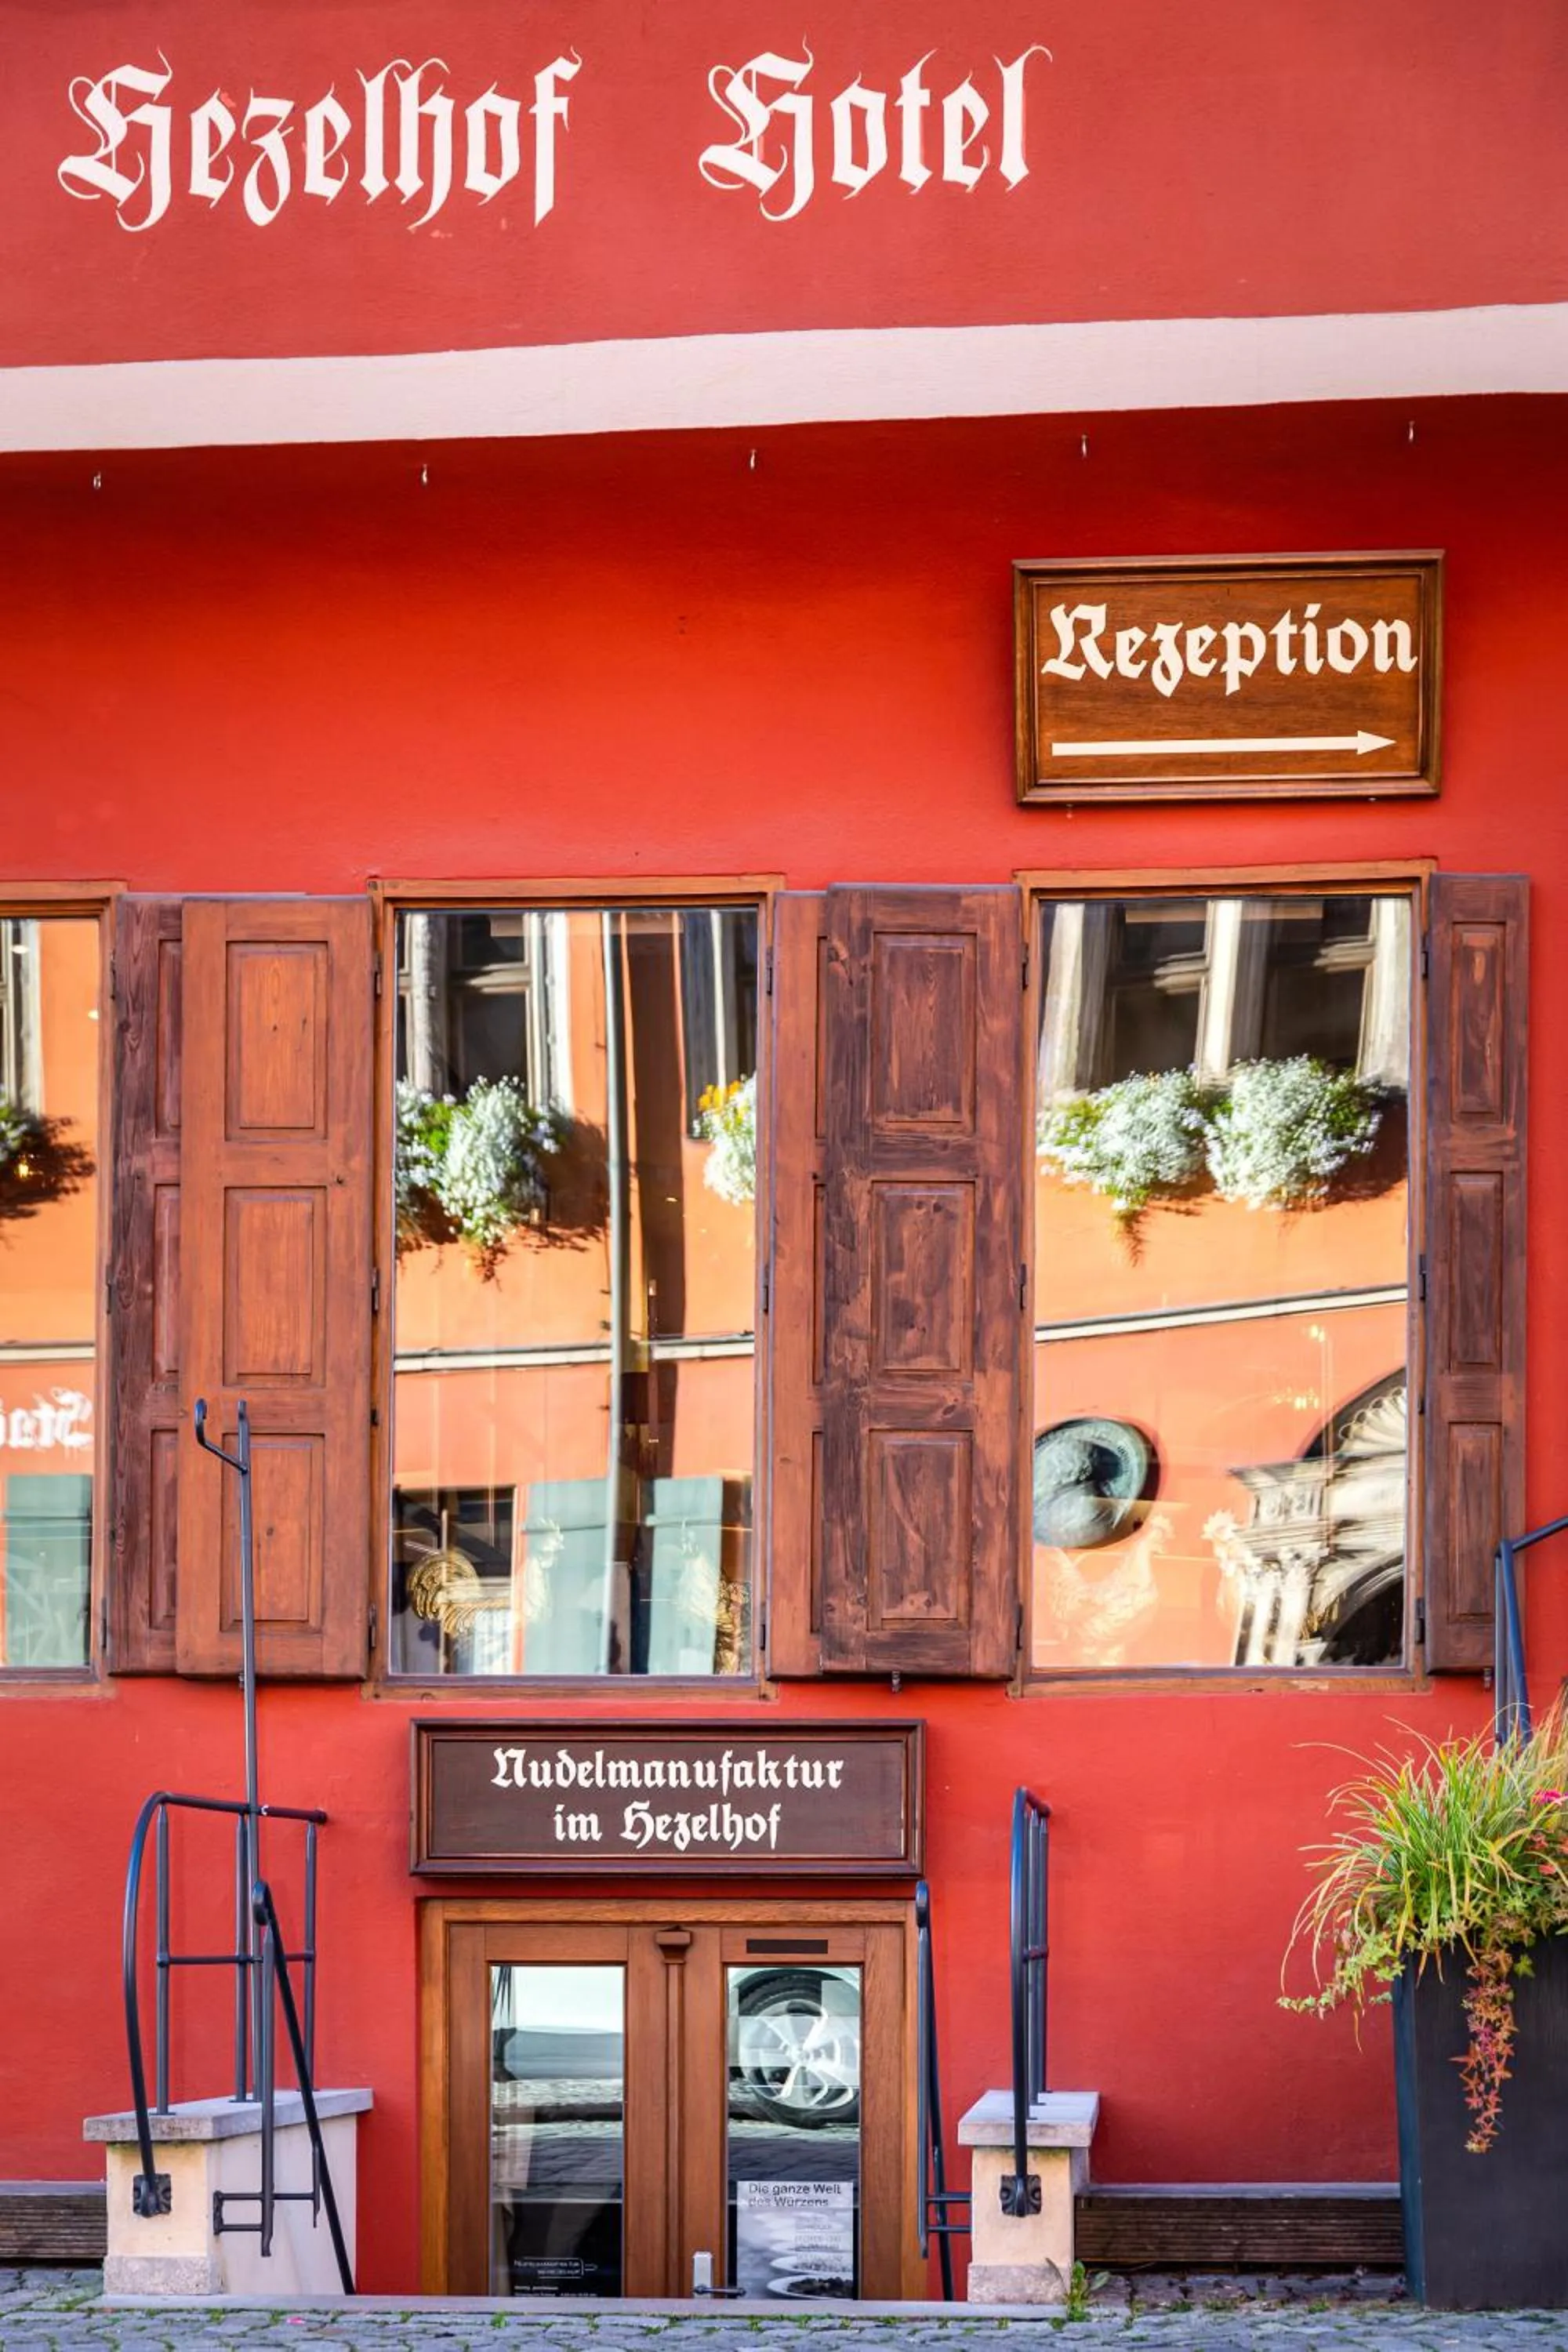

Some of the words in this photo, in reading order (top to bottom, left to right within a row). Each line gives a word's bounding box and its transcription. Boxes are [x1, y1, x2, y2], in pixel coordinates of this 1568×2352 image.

[57, 45, 583, 232] Hezelhof
[698, 34, 1053, 222] Hotel
[1040, 603, 1418, 698] Rezeption
[490, 1748, 844, 1797] Nudelmanufaktur
[553, 1804, 603, 1842] im
[619, 1800, 782, 1852] Hezelhof
[749, 2183, 769, 2194] Die
[772, 2185, 810, 2195] ganze
[814, 2183, 841, 2194] Welt
